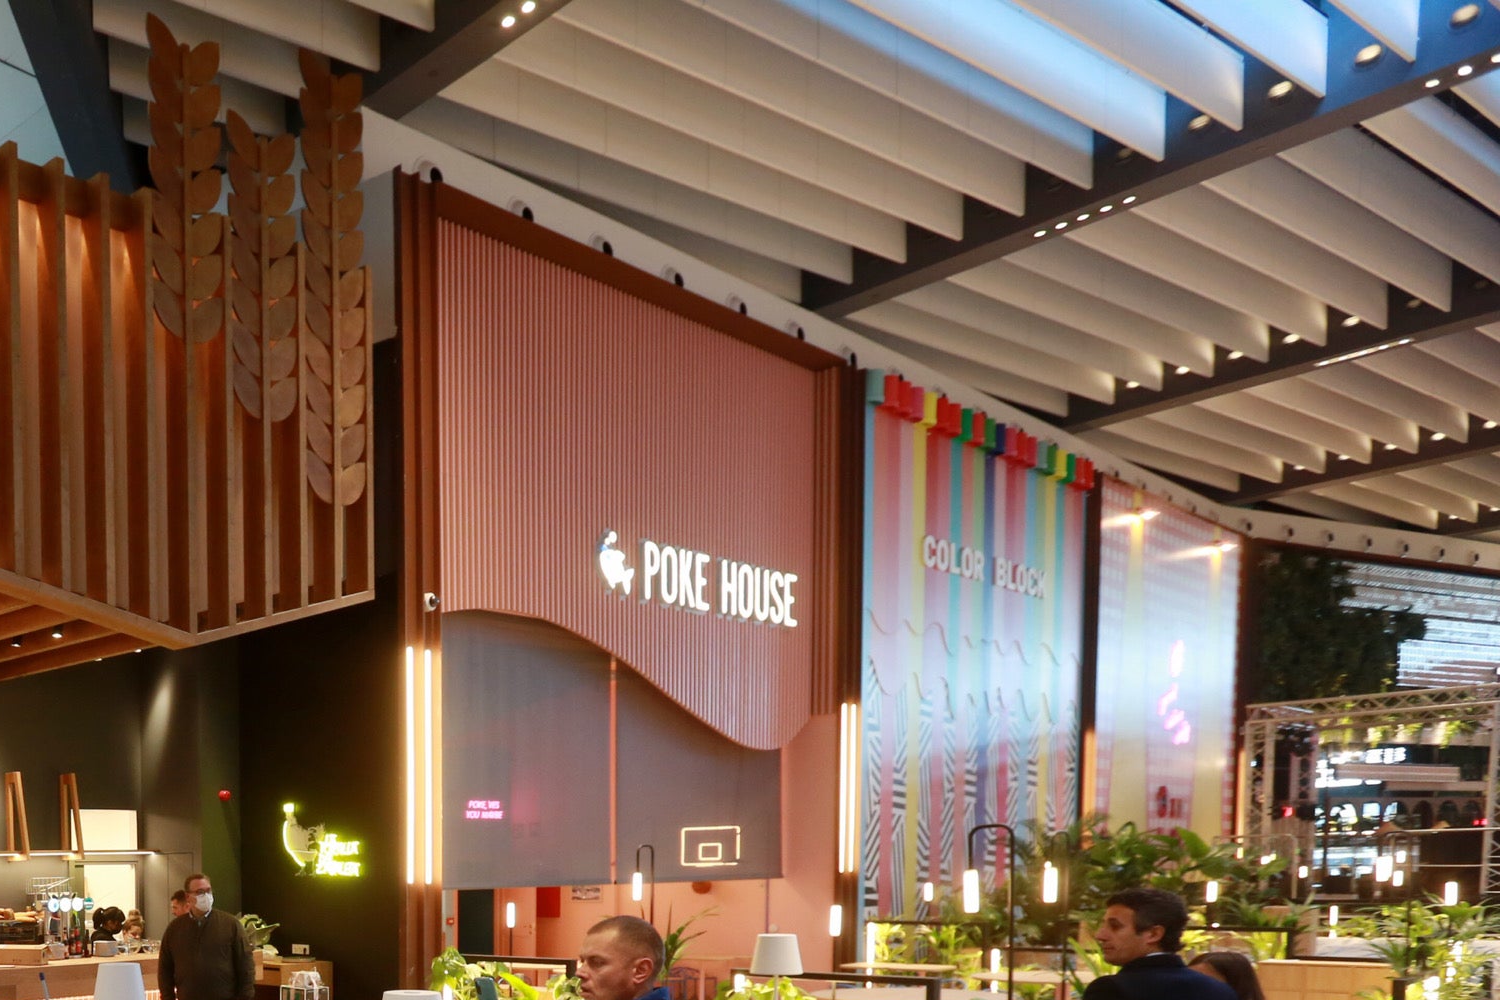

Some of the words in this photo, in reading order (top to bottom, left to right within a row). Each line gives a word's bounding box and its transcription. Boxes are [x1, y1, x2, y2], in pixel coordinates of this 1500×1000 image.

[642, 539, 710, 612] POKE
[719, 558, 798, 628] HOUSE
[922, 534, 985, 582] COLOR
[994, 556, 1047, 600] BLOCK
